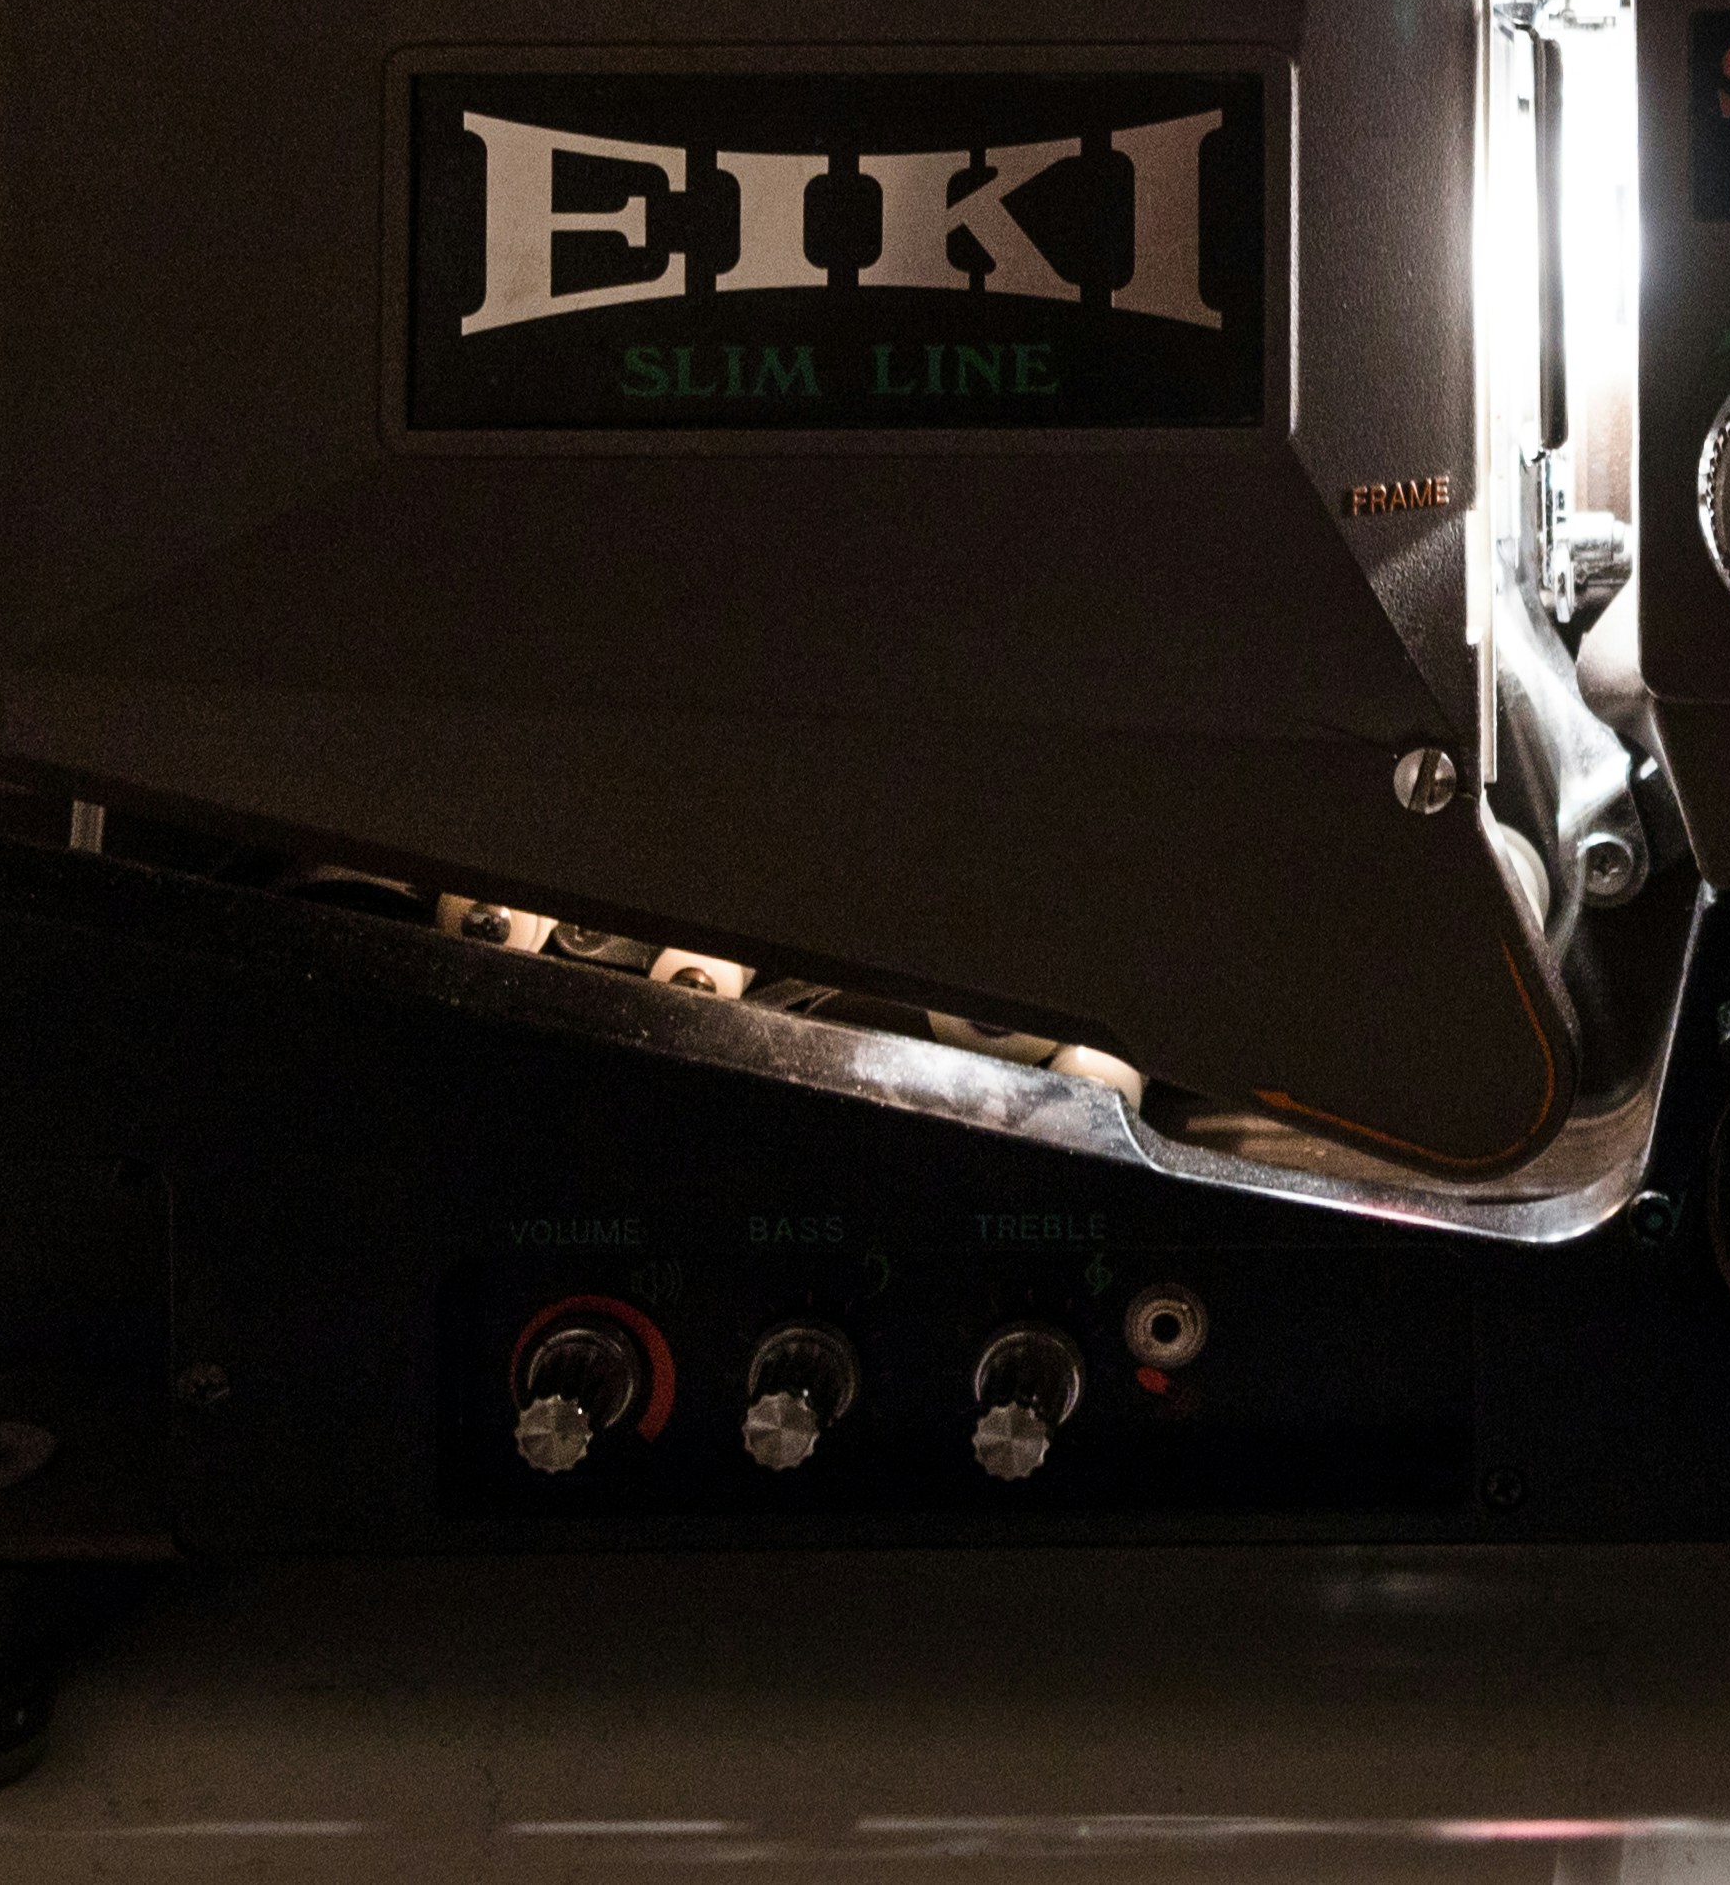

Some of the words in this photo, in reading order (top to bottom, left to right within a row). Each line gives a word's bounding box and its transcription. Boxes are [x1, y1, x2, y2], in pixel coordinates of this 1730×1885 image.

[461, 108, 1223, 337] EIKI
[622, 343, 829, 399] SLIM
[875, 341, 1061, 396] LINE
[1350, 475, 1451, 516] FRAME
[509, 1216, 643, 1247] VOLUME
[748, 1215, 845, 1244] BASS
[975, 1213, 1108, 1241] TREBLE
